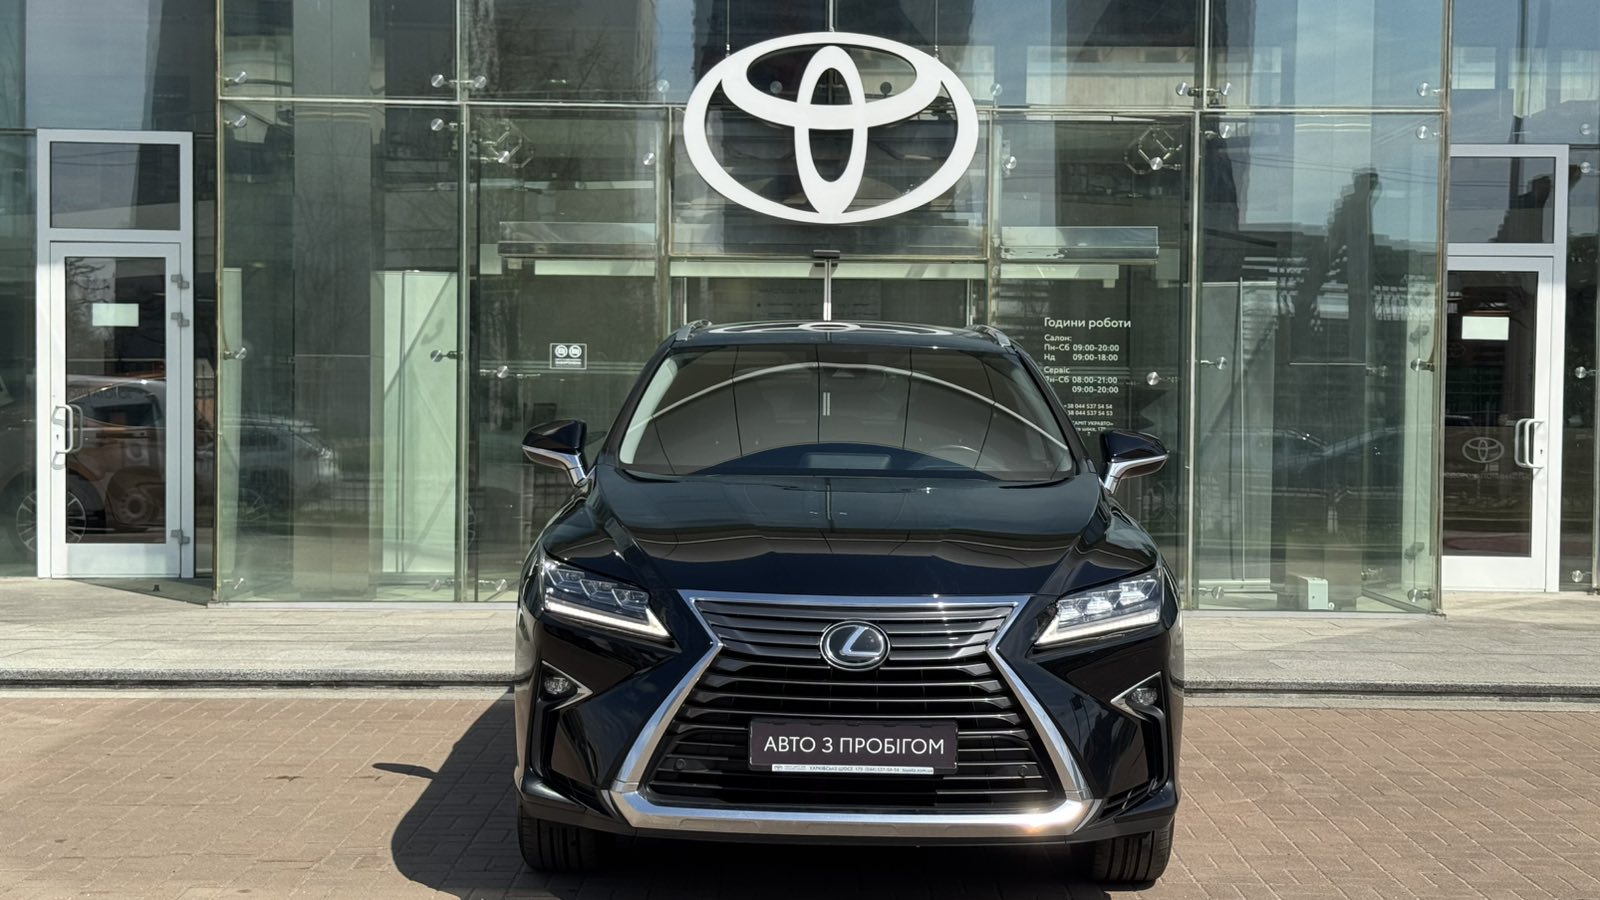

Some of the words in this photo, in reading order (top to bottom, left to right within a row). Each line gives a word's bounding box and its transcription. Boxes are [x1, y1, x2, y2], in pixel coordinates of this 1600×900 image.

[1044, 317, 1086, 329] Години
[1088, 317, 1132, 330] роботи
[1044, 333, 1072, 342] Салон:
[1044, 343, 1070, 351] Пн-Сб
[1072, 344, 1120, 352] 09:00-20:00
[1044, 353, 1056, 361] Нд
[1072, 353, 1119, 361] 09:00-18:00
[1072, 376, 1118, 384] 08:00-21:00
[1072, 386, 1119, 394] 09:00-20:00
[763, 736, 816, 753] АВТО
[839, 737, 945, 755] ПРОБІГОМ
